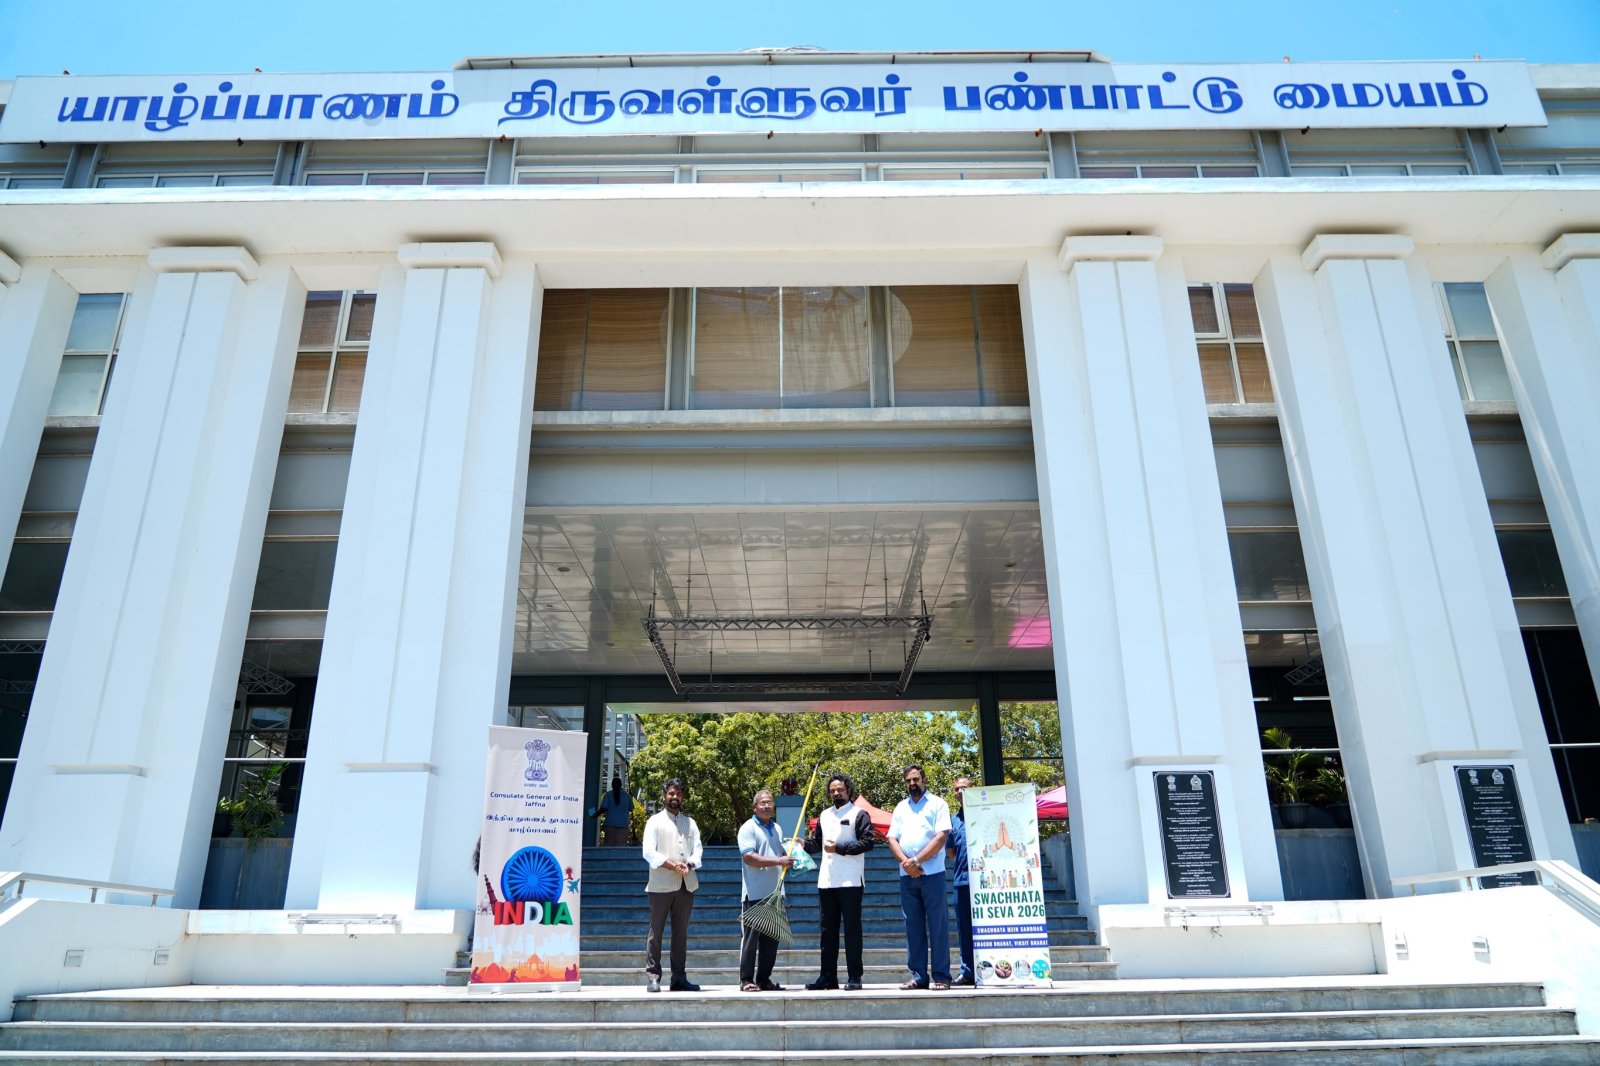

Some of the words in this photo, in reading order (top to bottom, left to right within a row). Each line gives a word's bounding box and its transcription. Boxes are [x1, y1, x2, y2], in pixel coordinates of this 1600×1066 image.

[58, 79, 459, 132] யாழ்ப்பாணம்
[497, 74, 913, 126] திருவள்ளுவர்
[943, 72, 1243, 114] பண்பாட்டு
[1274, 69, 1488, 109] மையம்
[490, 791, 524, 799] Consulate
[974, 890, 1041, 905] SWACHHATA
[494, 901, 574, 925] INDIA
[972, 907, 983, 919] HI
[987, 906, 1014, 919] SEVA
[1017, 904, 1045, 918] 2026
